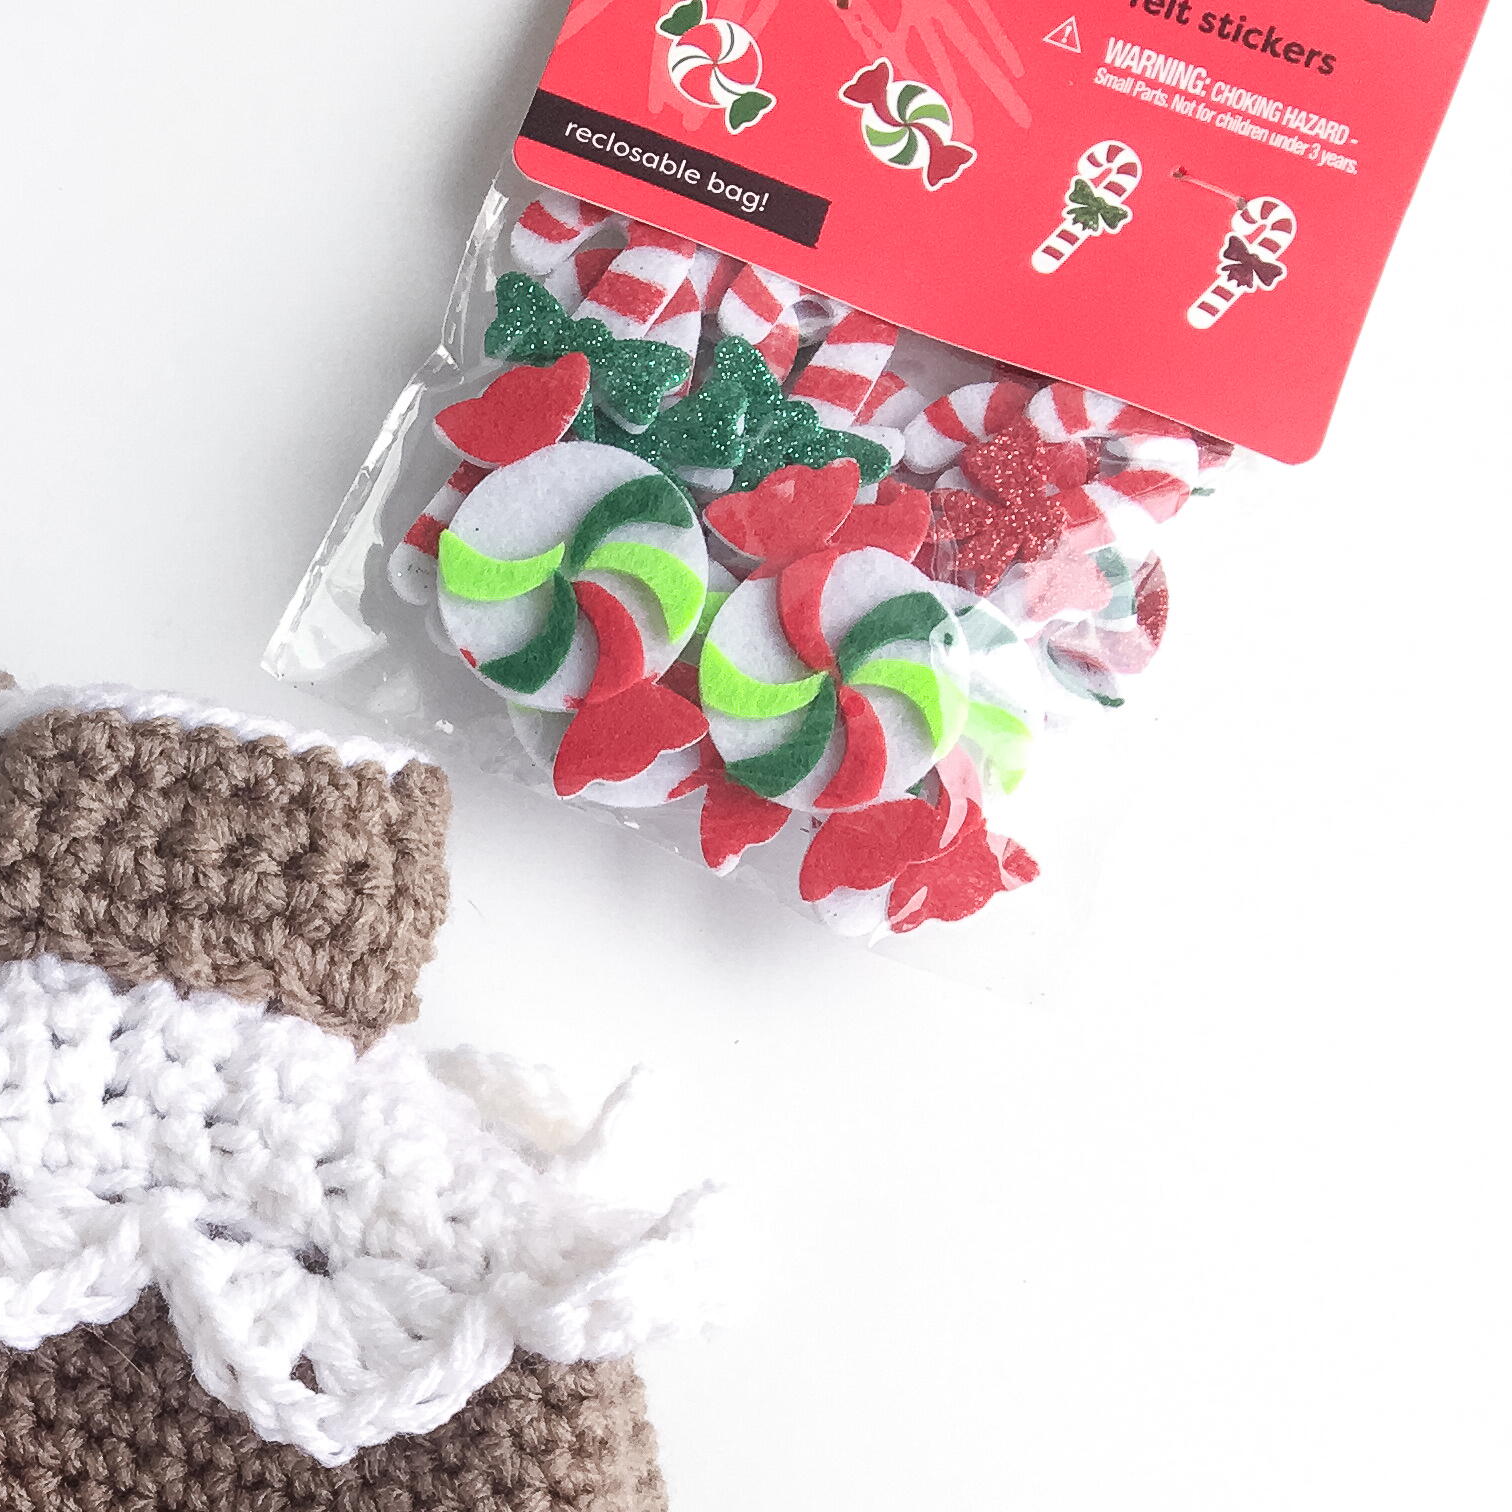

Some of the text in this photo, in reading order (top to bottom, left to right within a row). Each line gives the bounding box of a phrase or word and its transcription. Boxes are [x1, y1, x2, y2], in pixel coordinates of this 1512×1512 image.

[1130, 0, 1336, 75] elt stickers
[1094, 67, 1358, 175] Small Parts. Not for children under 3 years.
[1104, 37, 1212, 97] WARNING:
[1210, 81, 1284, 123] CHOKING
[1282, 105, 1350, 145] HAZARD
[564, 121, 770, 213] reclosable bag!
